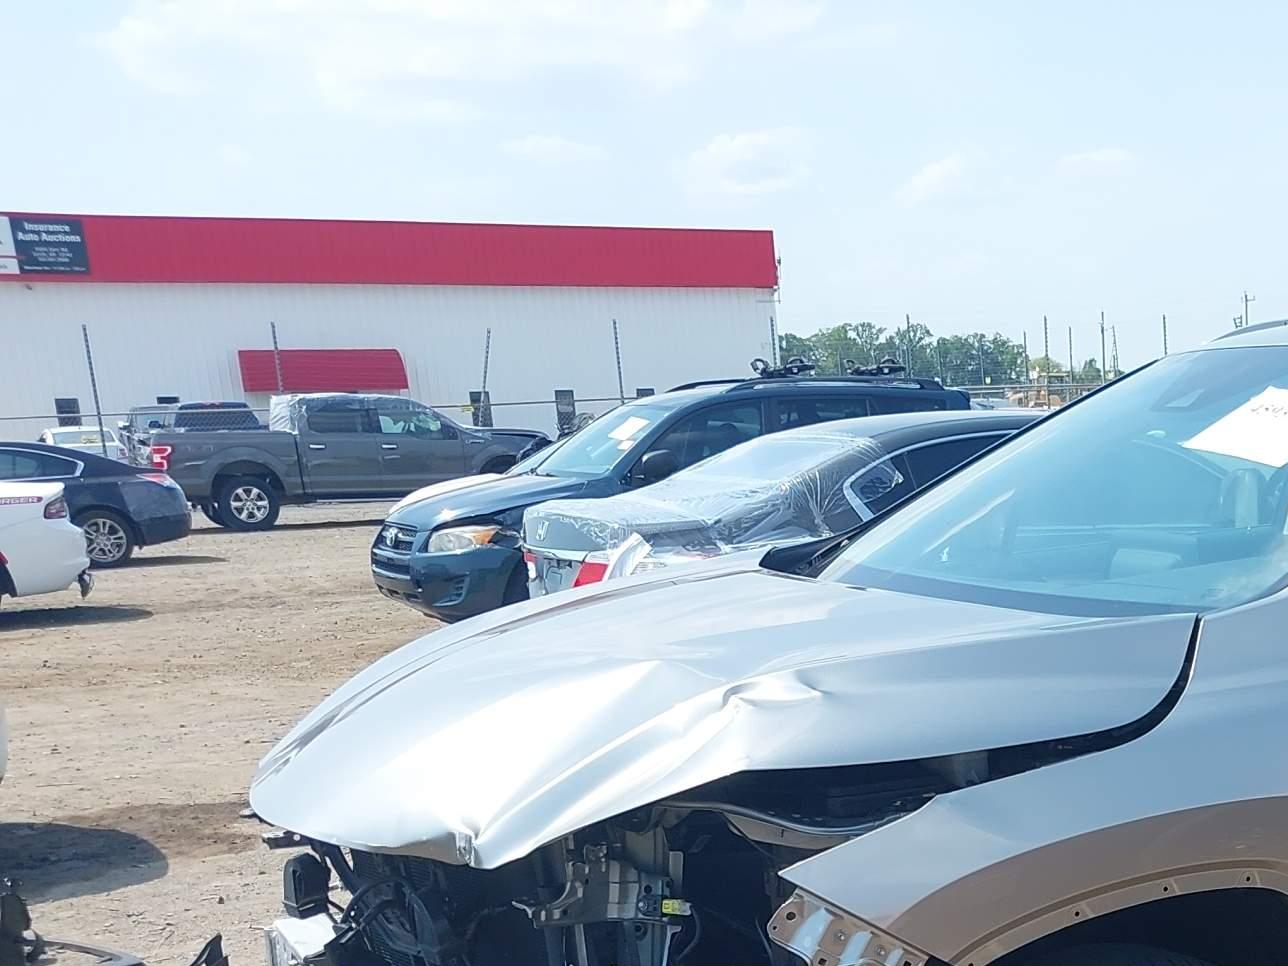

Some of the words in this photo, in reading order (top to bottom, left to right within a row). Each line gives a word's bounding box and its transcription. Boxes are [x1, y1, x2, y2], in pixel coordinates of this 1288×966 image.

[24, 221, 70, 231] Insurance
[17, 232, 39, 241] Auto
[41, 233, 81, 242] Auctions
